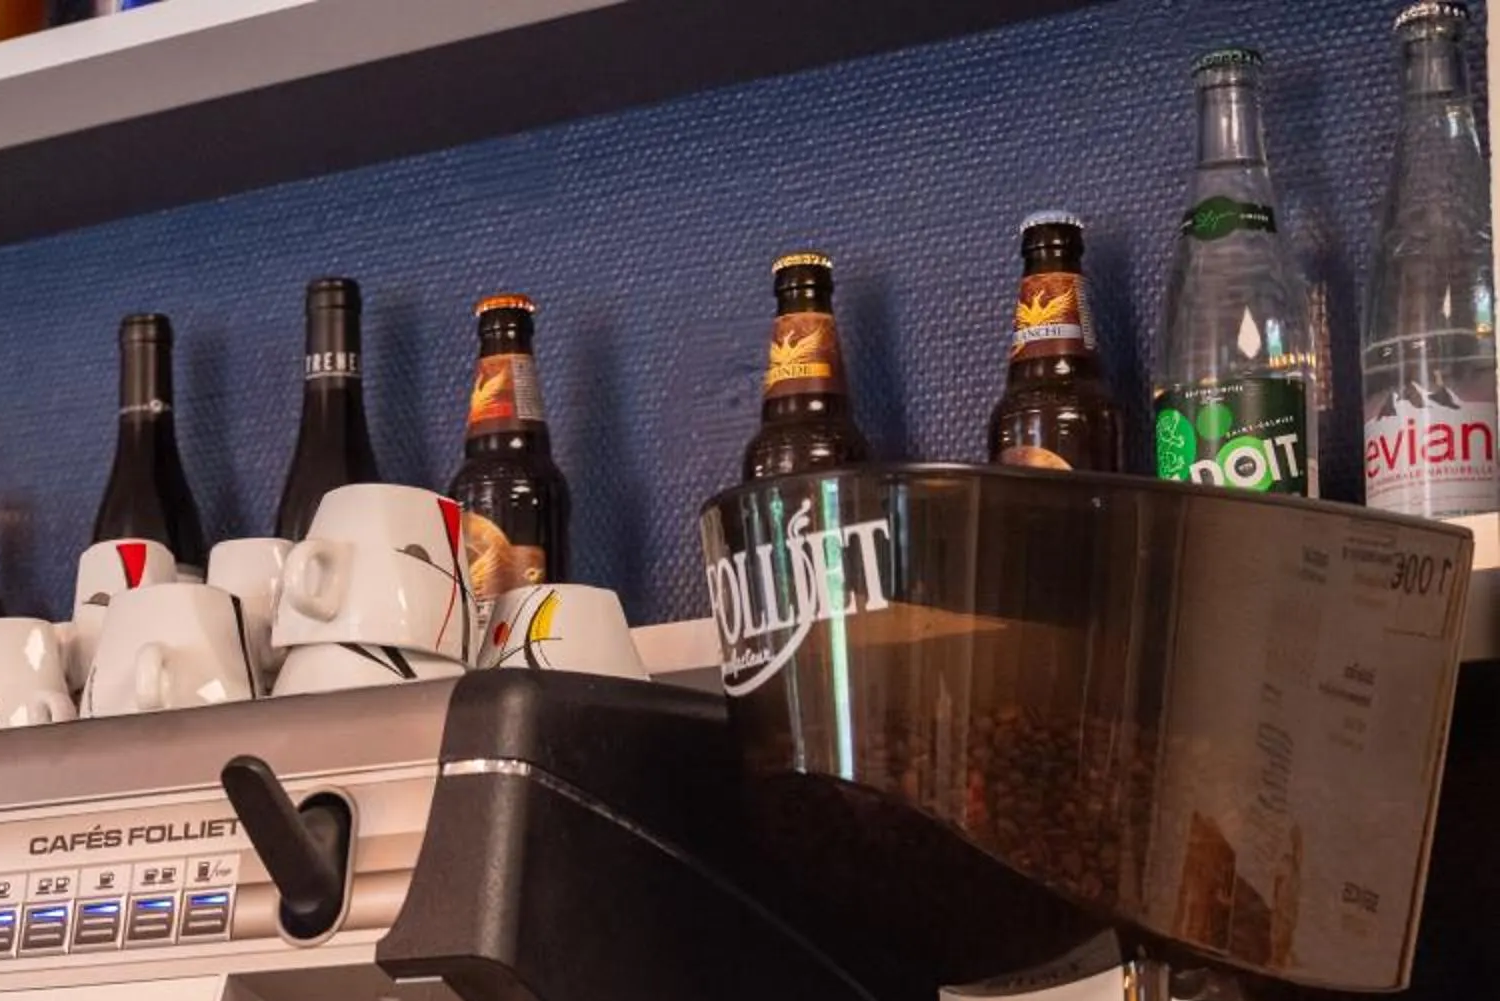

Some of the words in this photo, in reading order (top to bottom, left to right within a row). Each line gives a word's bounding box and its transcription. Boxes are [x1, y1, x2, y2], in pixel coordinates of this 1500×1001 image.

[1365, 418, 1494, 478] evian
[29, 824, 122, 855] CAFÉS
[127, 818, 239, 846] FOLLIET
